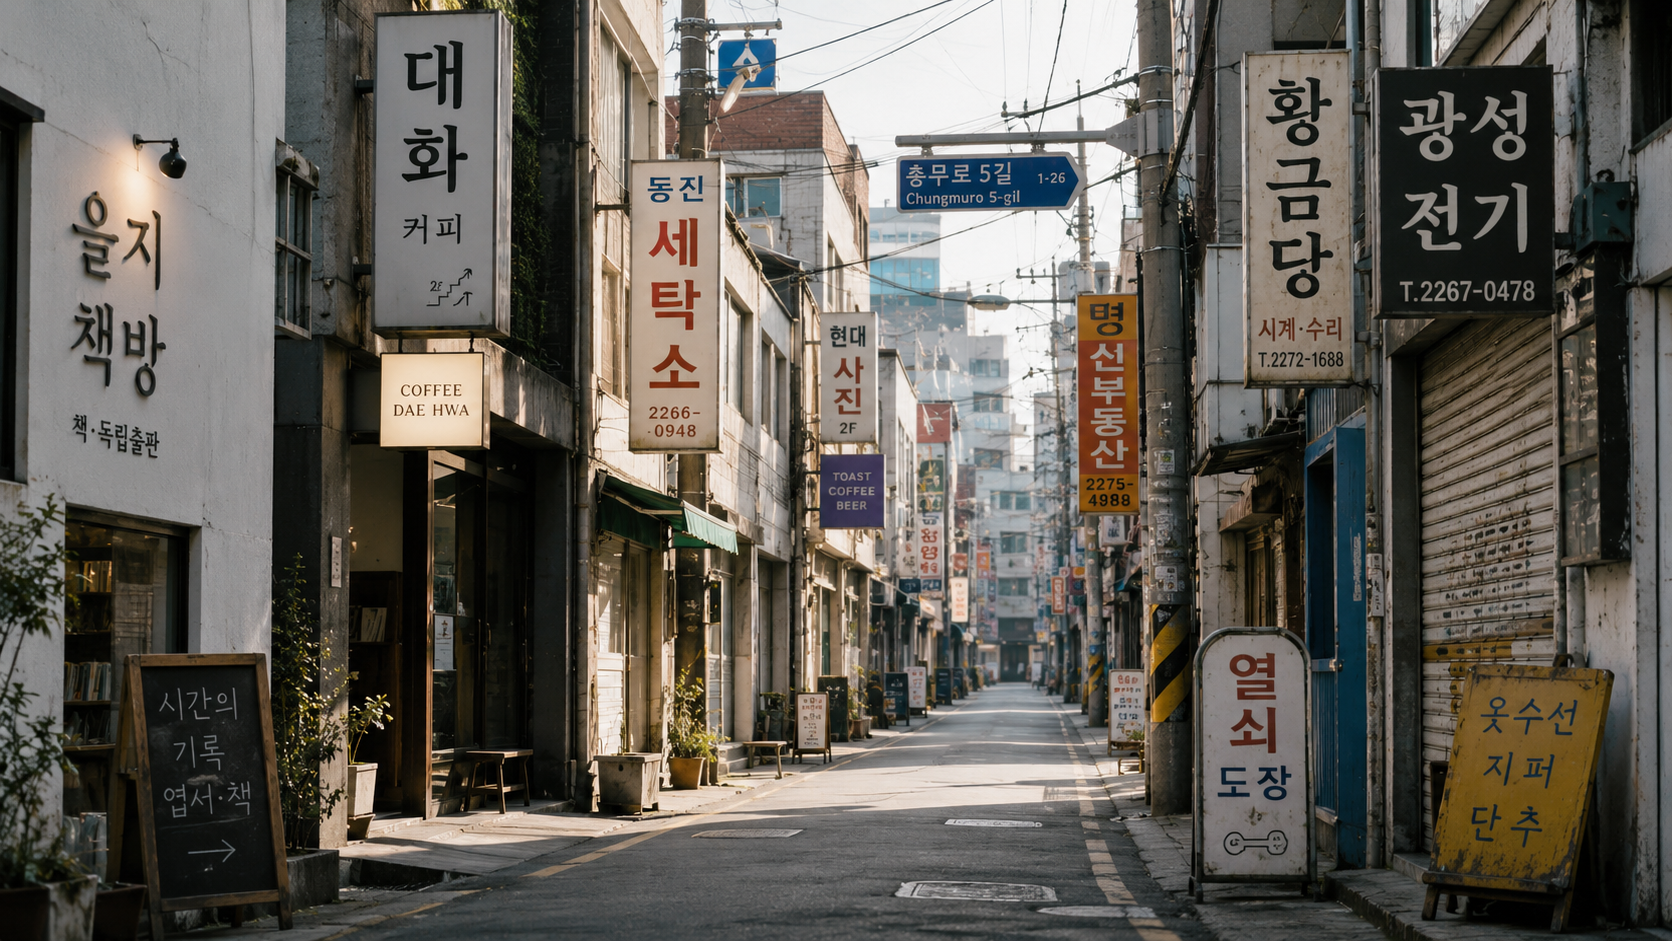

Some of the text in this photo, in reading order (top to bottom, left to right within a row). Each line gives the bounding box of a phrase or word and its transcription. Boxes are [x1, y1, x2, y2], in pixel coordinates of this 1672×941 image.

[402, 40, 468, 193] 대화
[1399, 90, 1528, 162] 광성
[979, 161, 1011, 185] 5길
[1037, 172, 1066, 184] 1-26
[647, 175, 703, 203] 동진
[906, 190, 1020, 207] Chungmuro 5-gil
[1266, 76, 1333, 299] 황금당
[402, 213, 462, 245] 커피
[1401, 182, 1528, 253] 전기
[71, 191, 161, 291] 을지
[648, 217, 701, 388] 세탁소
[1400, 279, 1535, 302] T.2267-0478
[70, 302, 166, 398] 책방
[829, 325, 866, 348] 현대
[1258, 351, 1344, 368] T.2272-1688
[400, 383, 463, 397] COFFEE
[833, 355, 864, 415] 사진
[393, 403, 470, 417] DAE HWA
[648, 405, 701, 420] 2266-
[839, 422, 857, 435] 2F
[832, 471, 872, 482] TOAST
[1086, 477, 1134, 491] 2275-
[828, 486, 876, 496] COFFEE
[1088, 494, 1131, 507] 4988
[836, 500, 867, 511] BEER
[158, 687, 238, 720] 시간의
[1228, 652, 1277, 754] 열쇠
[173, 735, 225, 771] 기록
[1217, 765, 1292, 801] 도장
[1483, 752, 1555, 790] 지퍼
[1471, 804, 1542, 848] 단추
